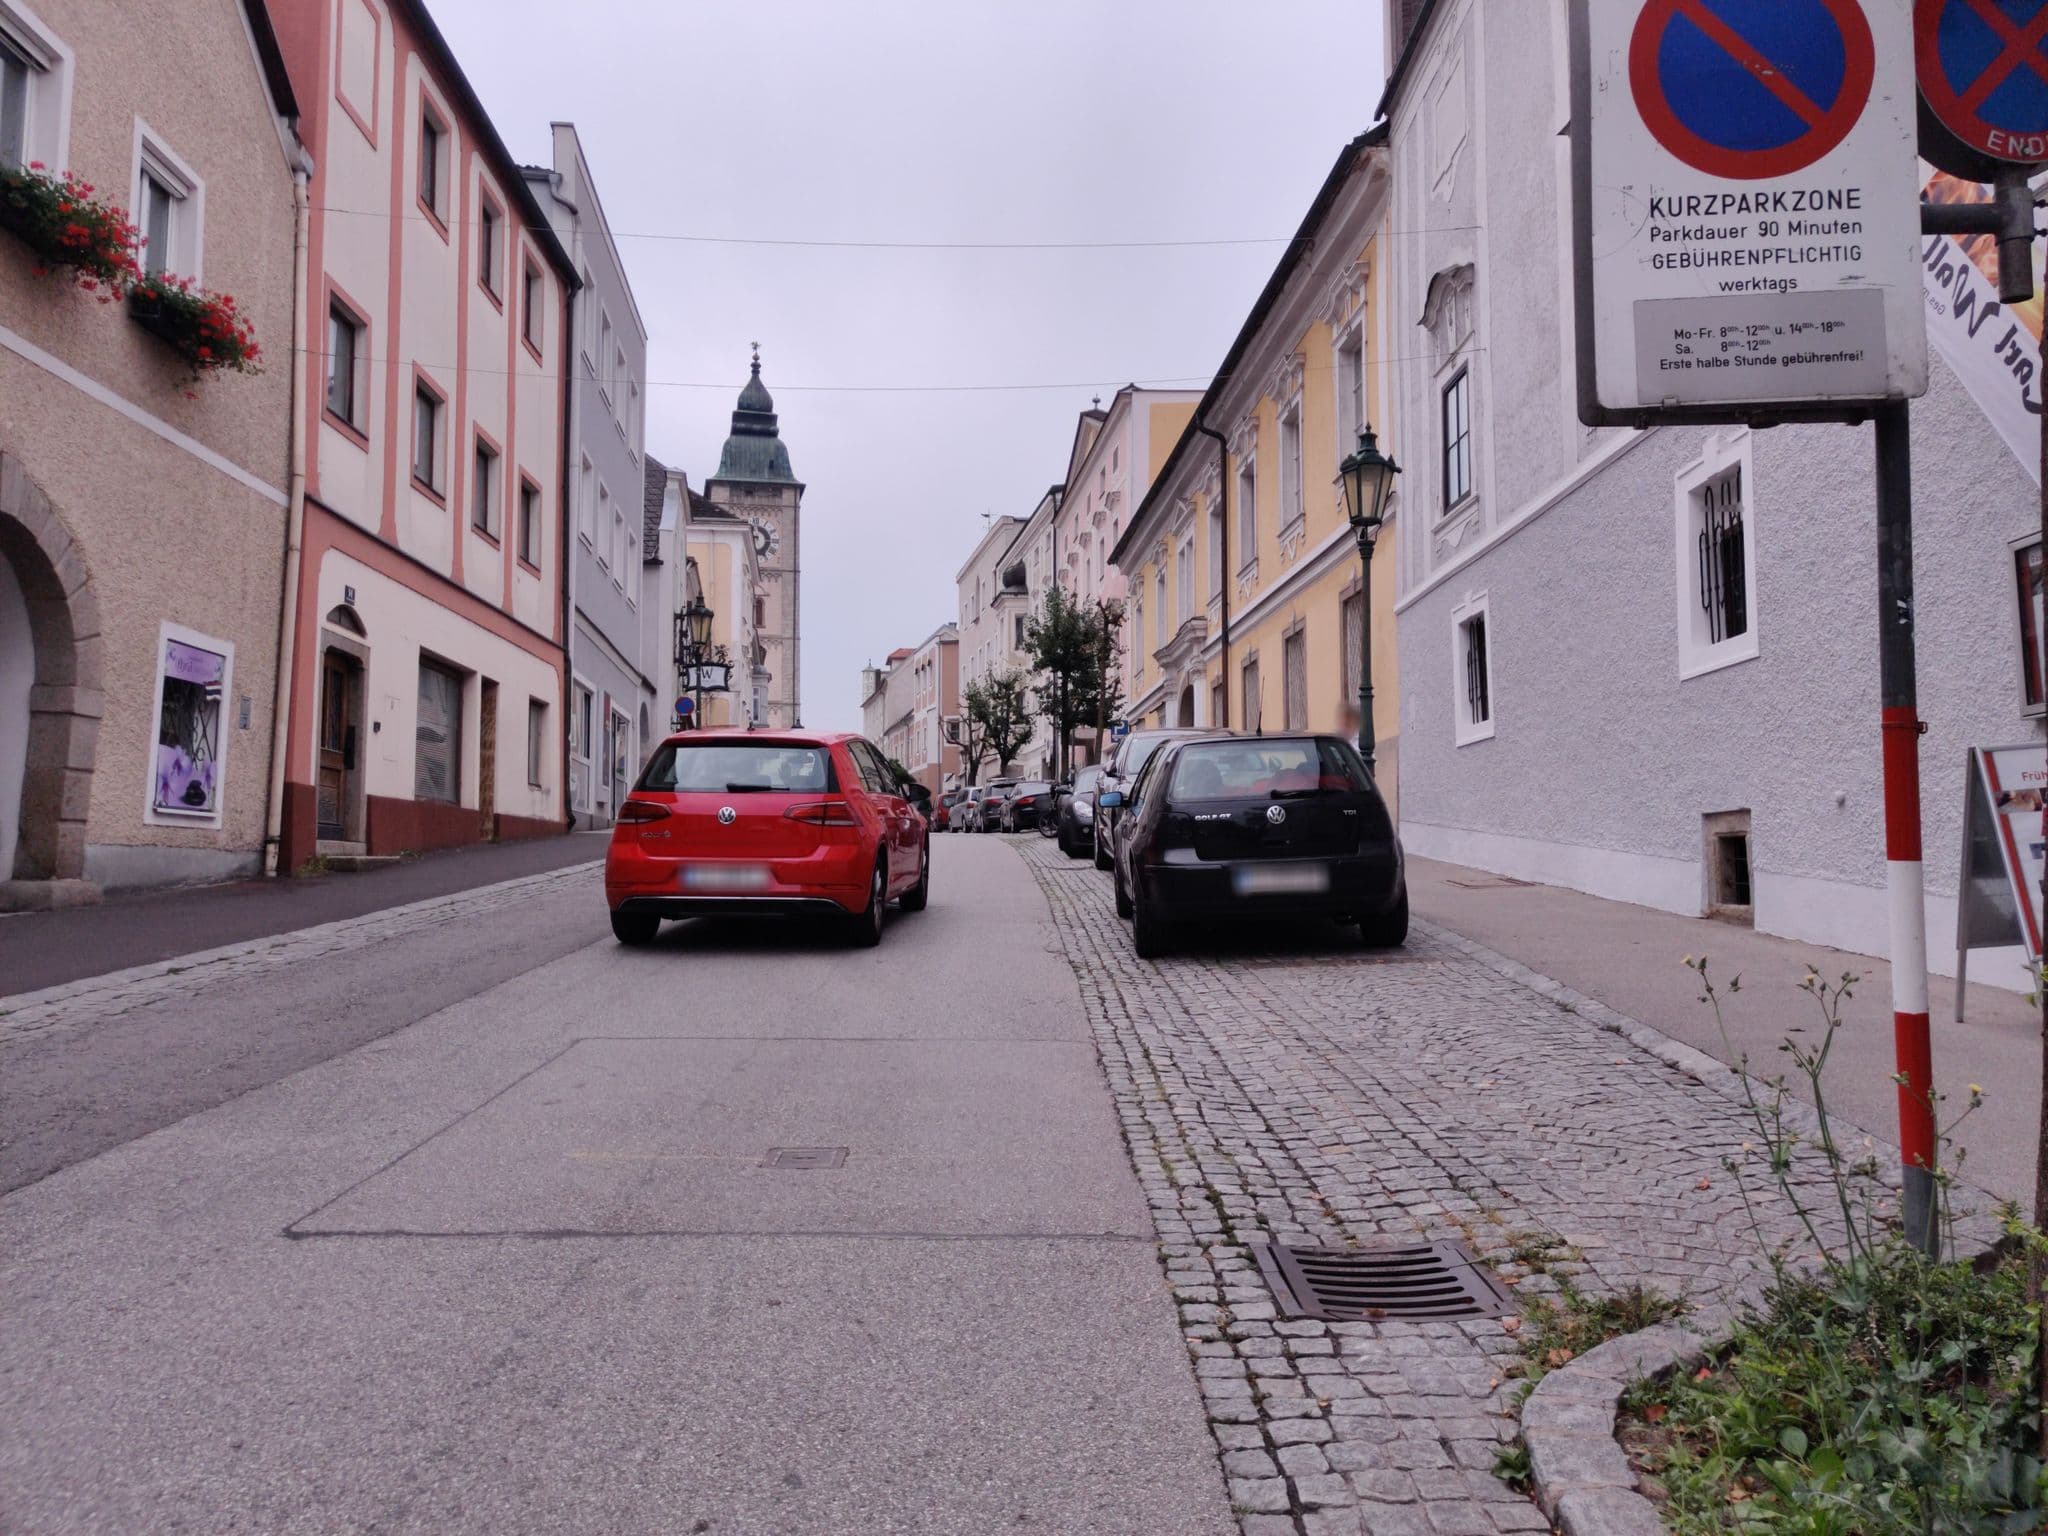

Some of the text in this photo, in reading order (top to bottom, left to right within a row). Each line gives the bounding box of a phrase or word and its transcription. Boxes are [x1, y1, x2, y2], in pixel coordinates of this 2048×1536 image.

[1987, 130, 2048, 157] END
[1650, 188, 1862, 218] KURZPARKZONE
[1650, 219, 1862, 243] Parkdauer 90 Minuten
[1652, 245, 1862, 269] GEBÜHRENPFLICHTIG
[1718, 277, 1798, 293] werktags
[1674, 327, 1716, 340] Mo-Fr.
[1774, 328, 1786, 336] u.
[1675, 343, 1694, 355] Sa.
[1660, 350, 1865, 371] Erste halbe Stunde gebührenfrei!
